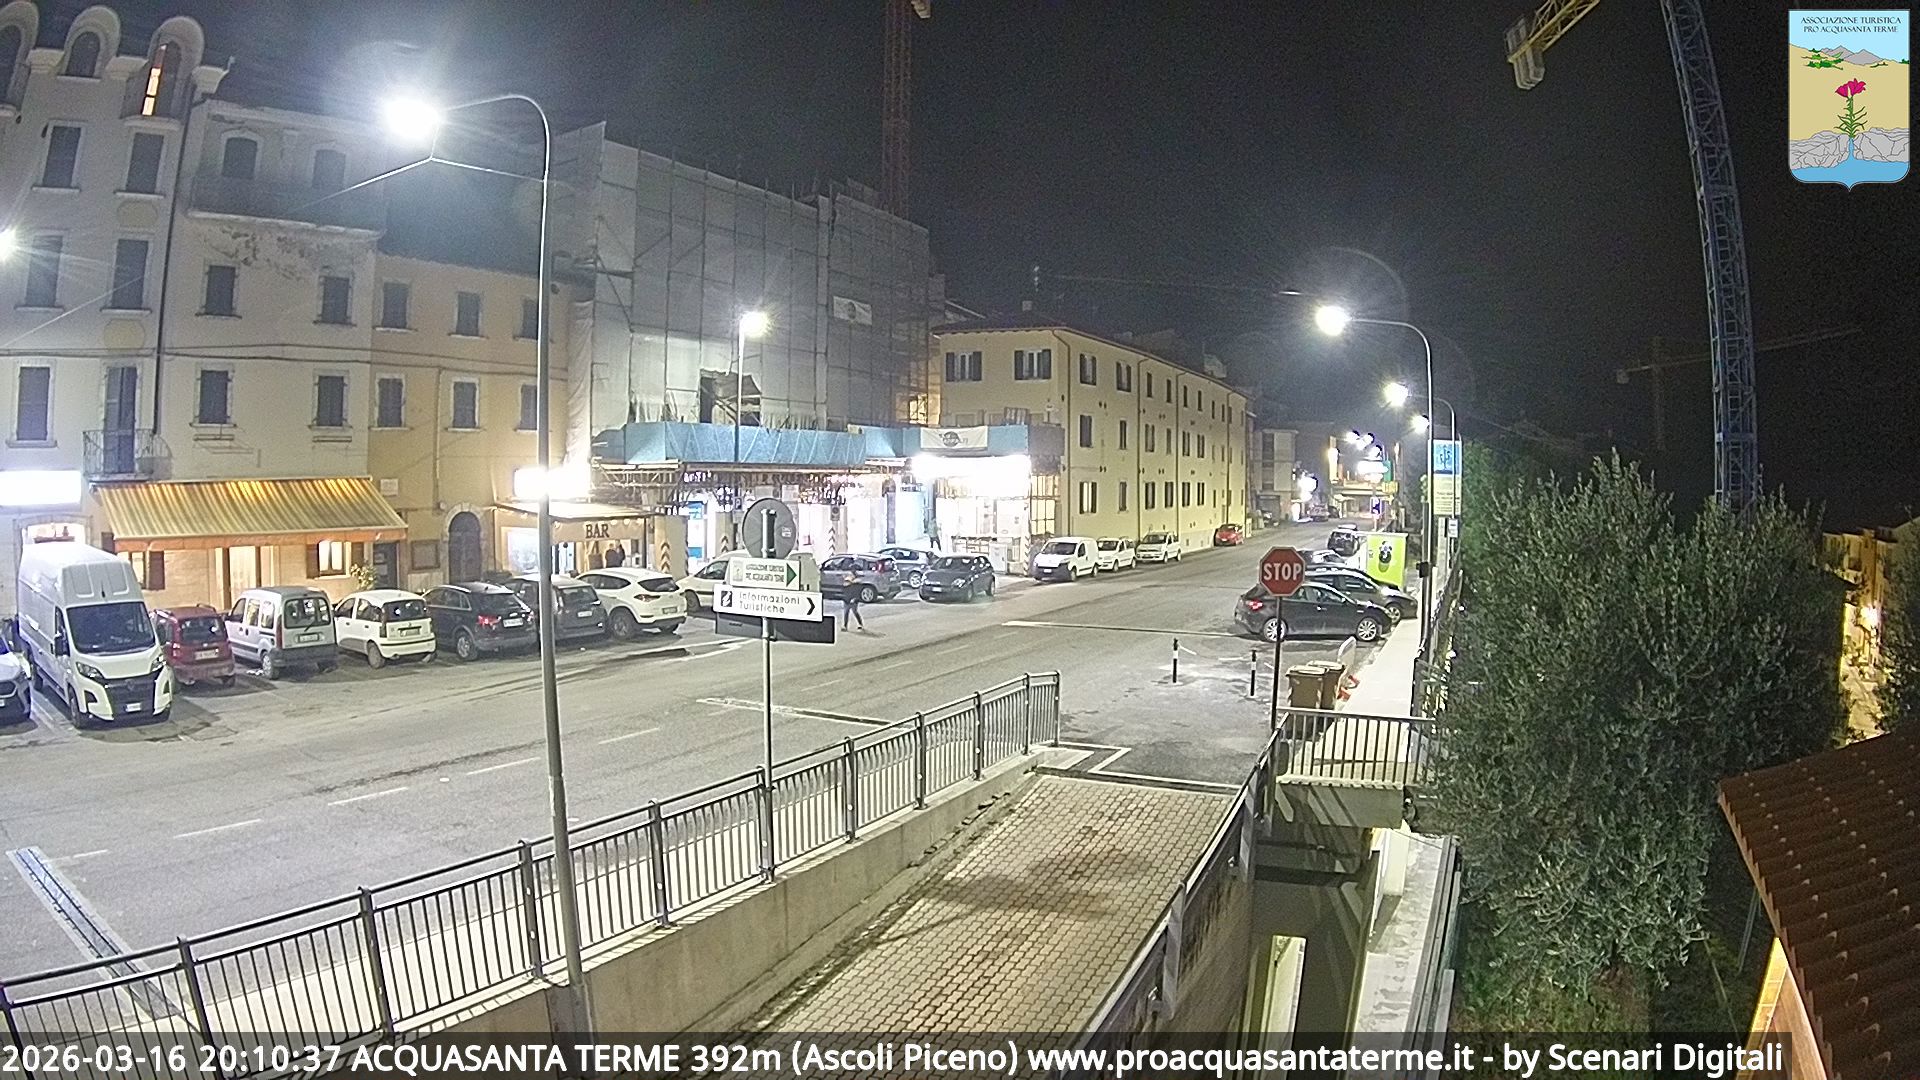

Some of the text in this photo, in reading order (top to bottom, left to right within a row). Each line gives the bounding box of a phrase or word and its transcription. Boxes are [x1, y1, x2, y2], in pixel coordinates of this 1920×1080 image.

[585, 523, 610, 538] BAR
[1263, 562, 1302, 581] STOP
[739, 591, 800, 604] Informazioni
[739, 600, 785, 613] Turistiche
